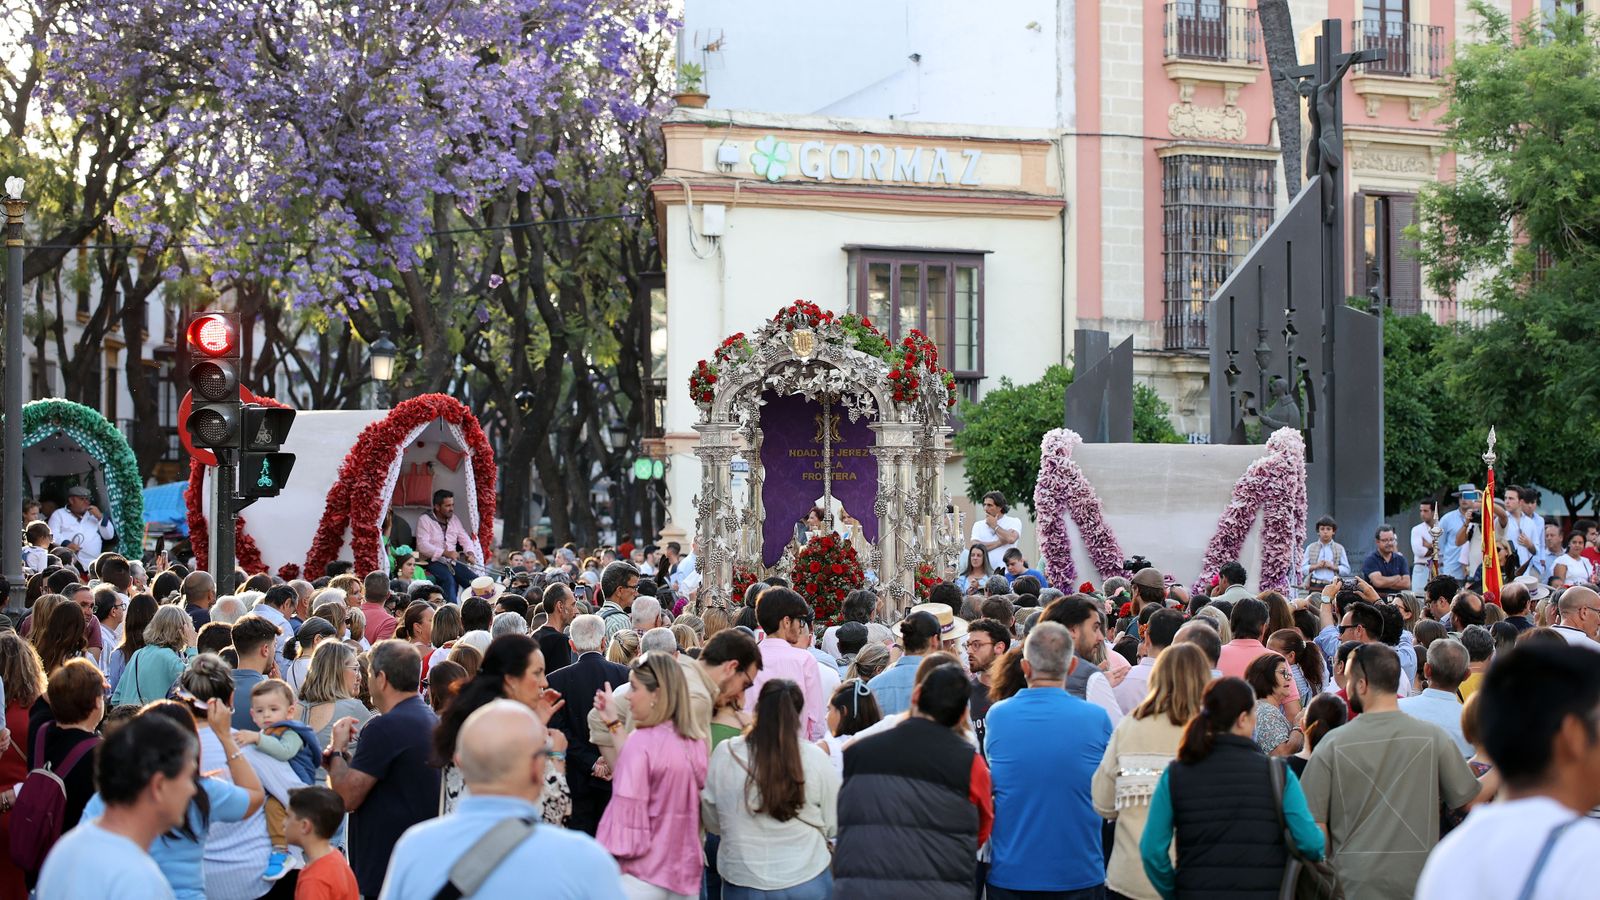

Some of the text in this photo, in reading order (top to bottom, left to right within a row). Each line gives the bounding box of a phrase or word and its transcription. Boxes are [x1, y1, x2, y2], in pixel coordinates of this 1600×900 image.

[799, 140, 982, 185] GORMAZ
[789, 449, 820, 457] HDAD.
[837, 449, 868, 457] JEREZ
[802, 472, 857, 480] FROTERA
